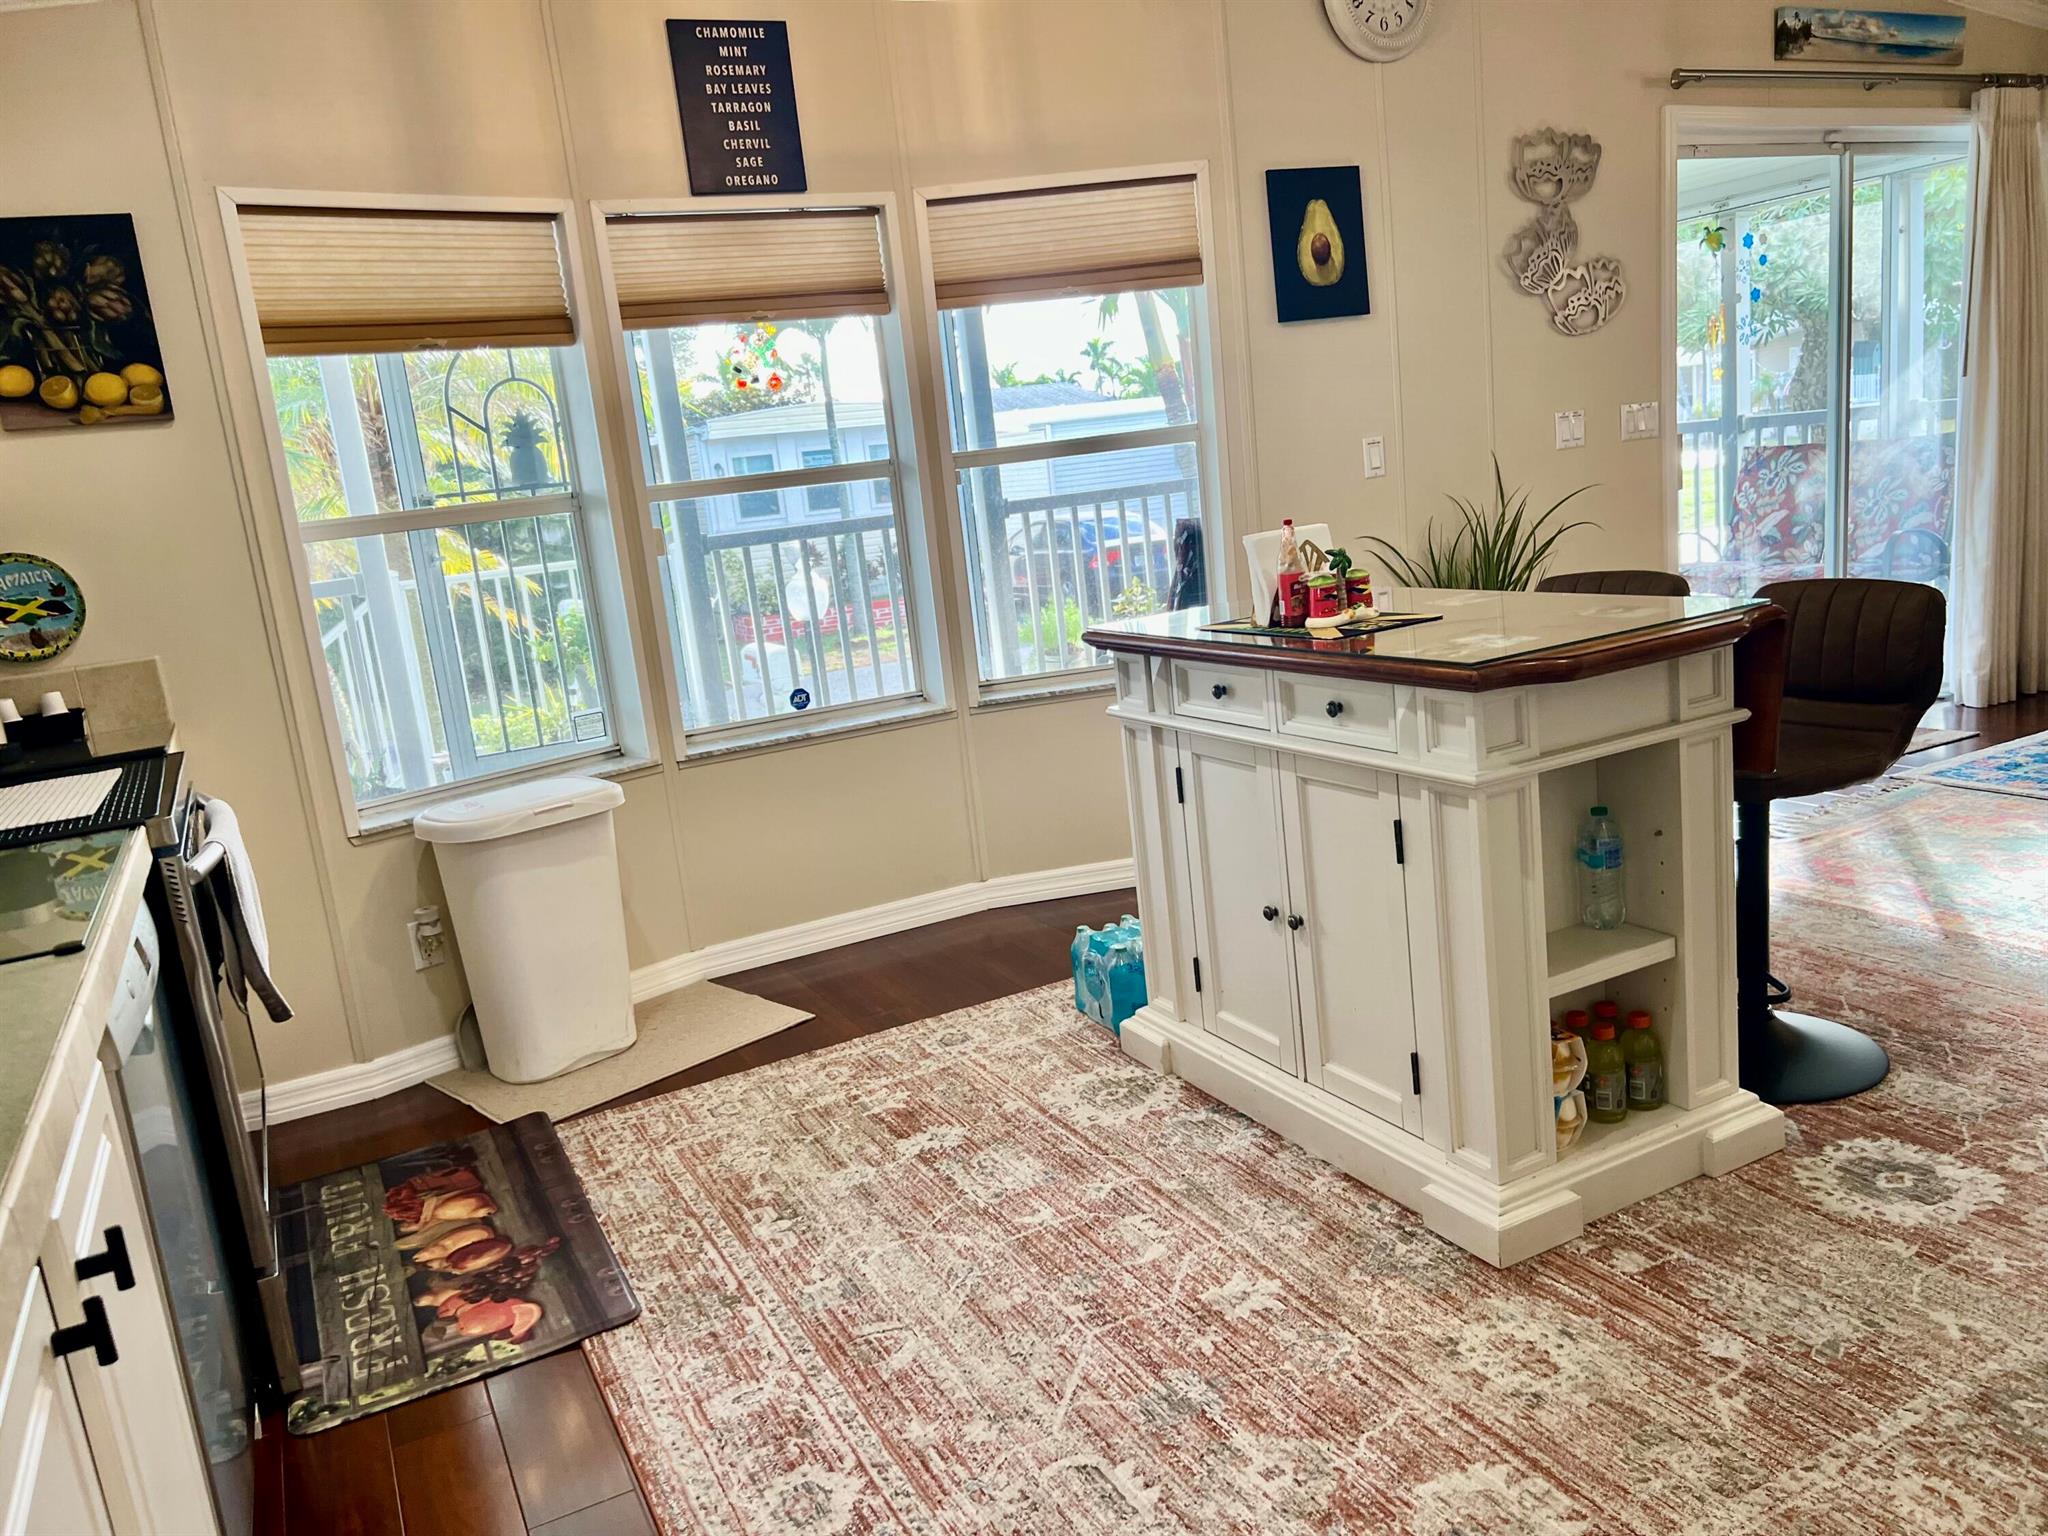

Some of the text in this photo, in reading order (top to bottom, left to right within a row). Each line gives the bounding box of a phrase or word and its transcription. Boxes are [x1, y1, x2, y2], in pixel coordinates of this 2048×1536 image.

[1365, 10, 1375, 23] 7
[1380, 16, 1388, 32] 6
[695, 27, 766, 39] CHAMOMILE
[719, 46, 748, 58] MINT
[705, 65, 767, 77] ROSEMARY
[705, 83, 772, 95] BAY LEAVES
[711, 102, 772, 114] TARRAGON
[728, 120, 761, 132] BASIL
[723, 138, 771, 150] CHERVIL
[735, 156, 764, 168] SAGE
[725, 174, 779, 187] OREGANO
[793, 693, 808, 704] ADT
[321, 1180, 408, 1379] FRESH FRUIT
